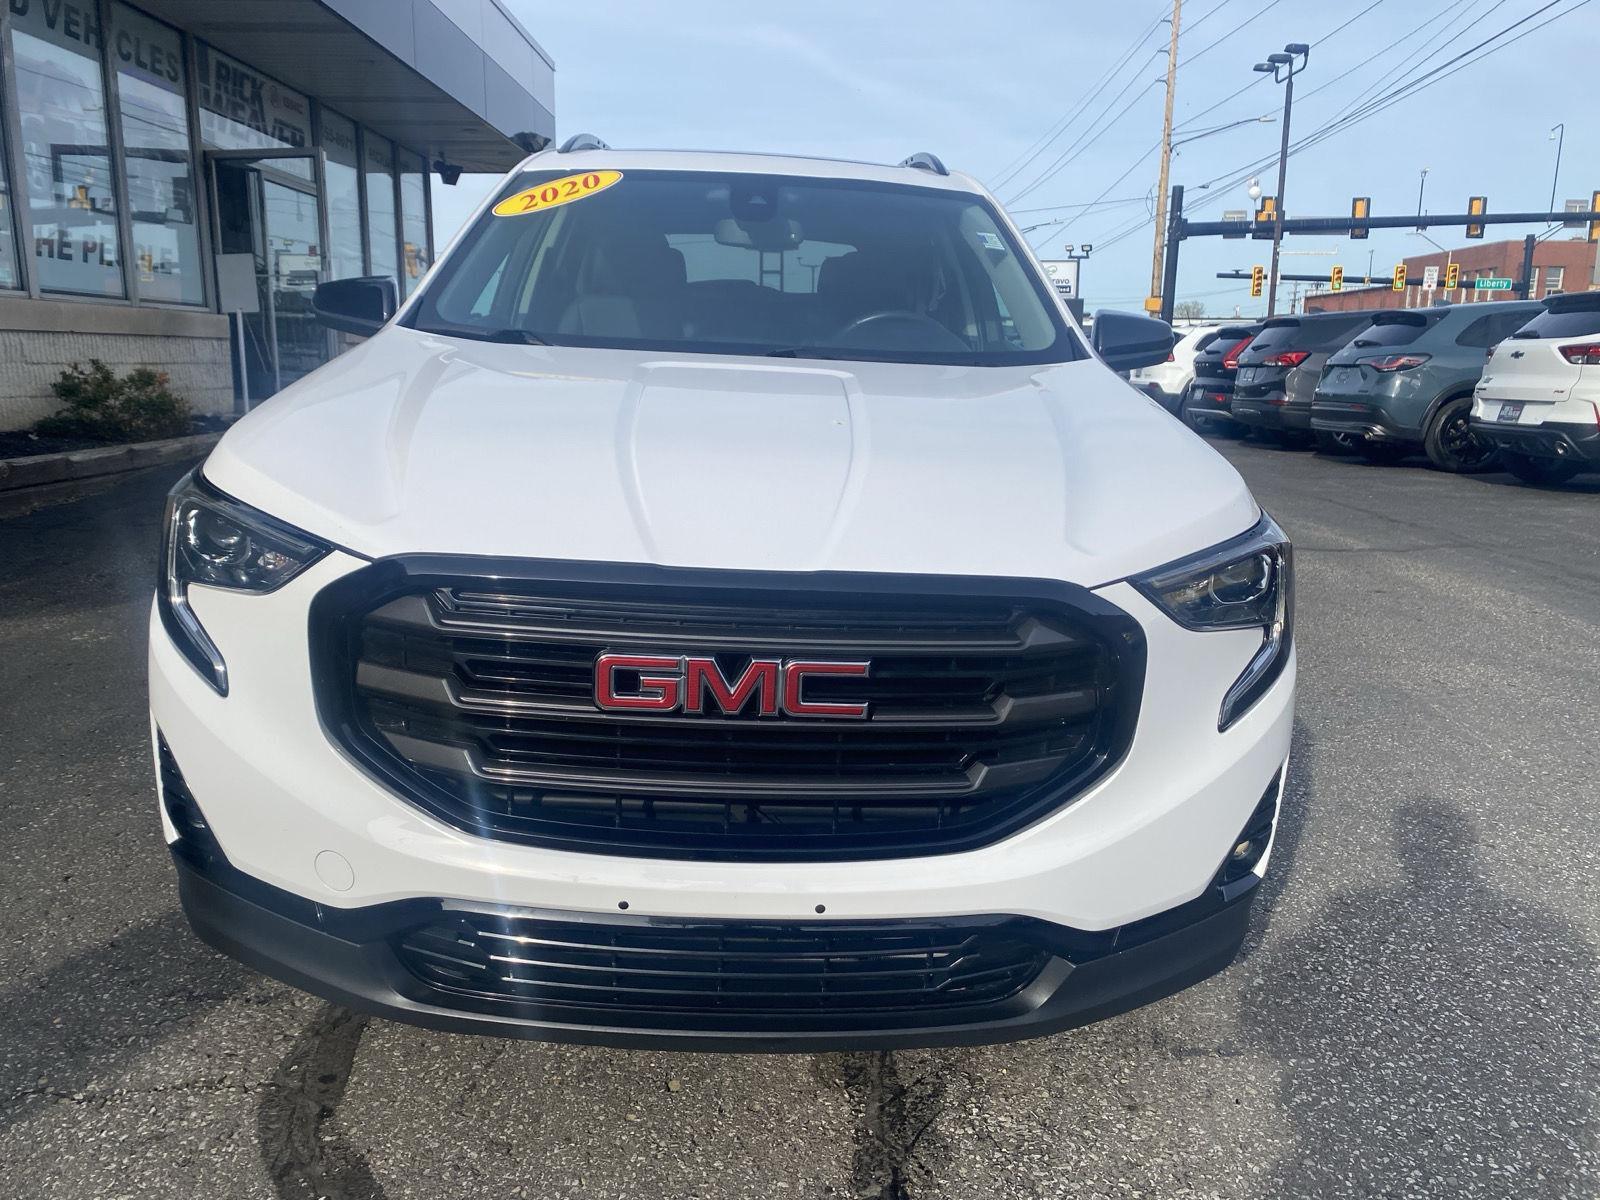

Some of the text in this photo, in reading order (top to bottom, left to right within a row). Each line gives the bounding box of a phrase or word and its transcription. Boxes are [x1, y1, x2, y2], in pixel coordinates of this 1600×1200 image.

[520, 174, 600, 210] 2020
[1480, 280, 1508, 288] Liberty
[593, 653, 871, 720] GMC
